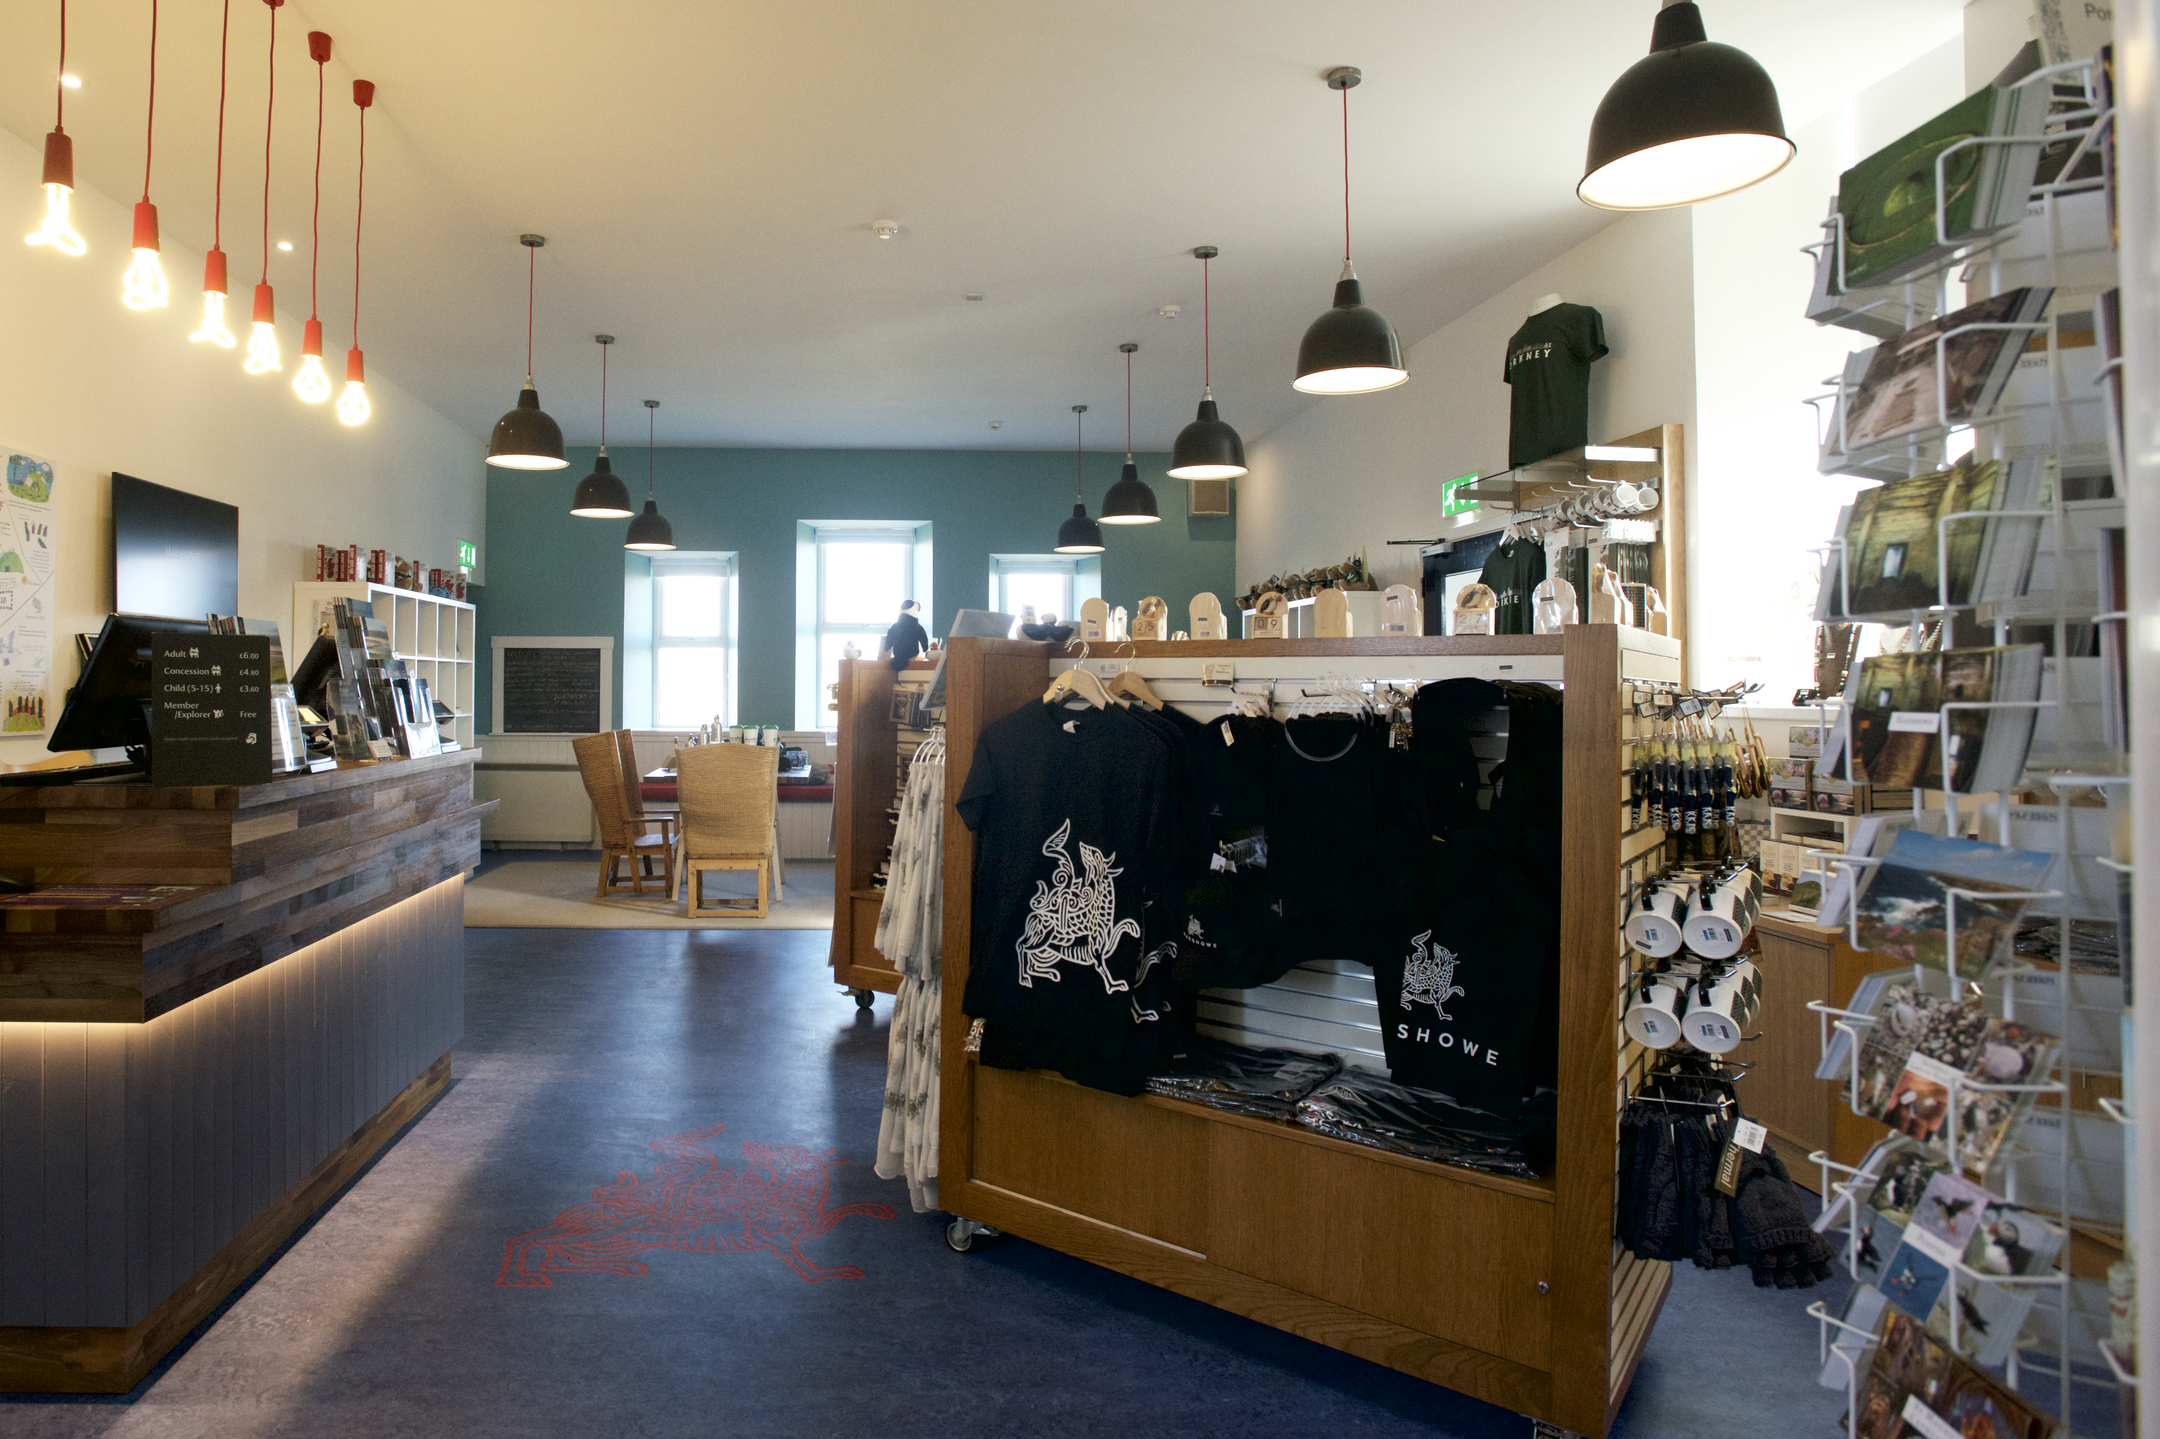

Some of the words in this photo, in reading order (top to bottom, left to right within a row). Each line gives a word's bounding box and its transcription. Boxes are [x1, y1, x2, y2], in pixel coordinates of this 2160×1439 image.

[164, 649, 187, 658] Adult
[239, 652, 259, 660] £6.00
[164, 667, 210, 675] Concession
[164, 684, 186, 692] Child
[187, 684, 214, 694] (5-15)
[239, 685, 260, 693] £3.60
[164, 702, 199, 710] Member
[174, 710, 211, 720] /Explorer
[239, 710, 257, 718] Free
[1397, 1023, 1499, 1066] SHOWE
